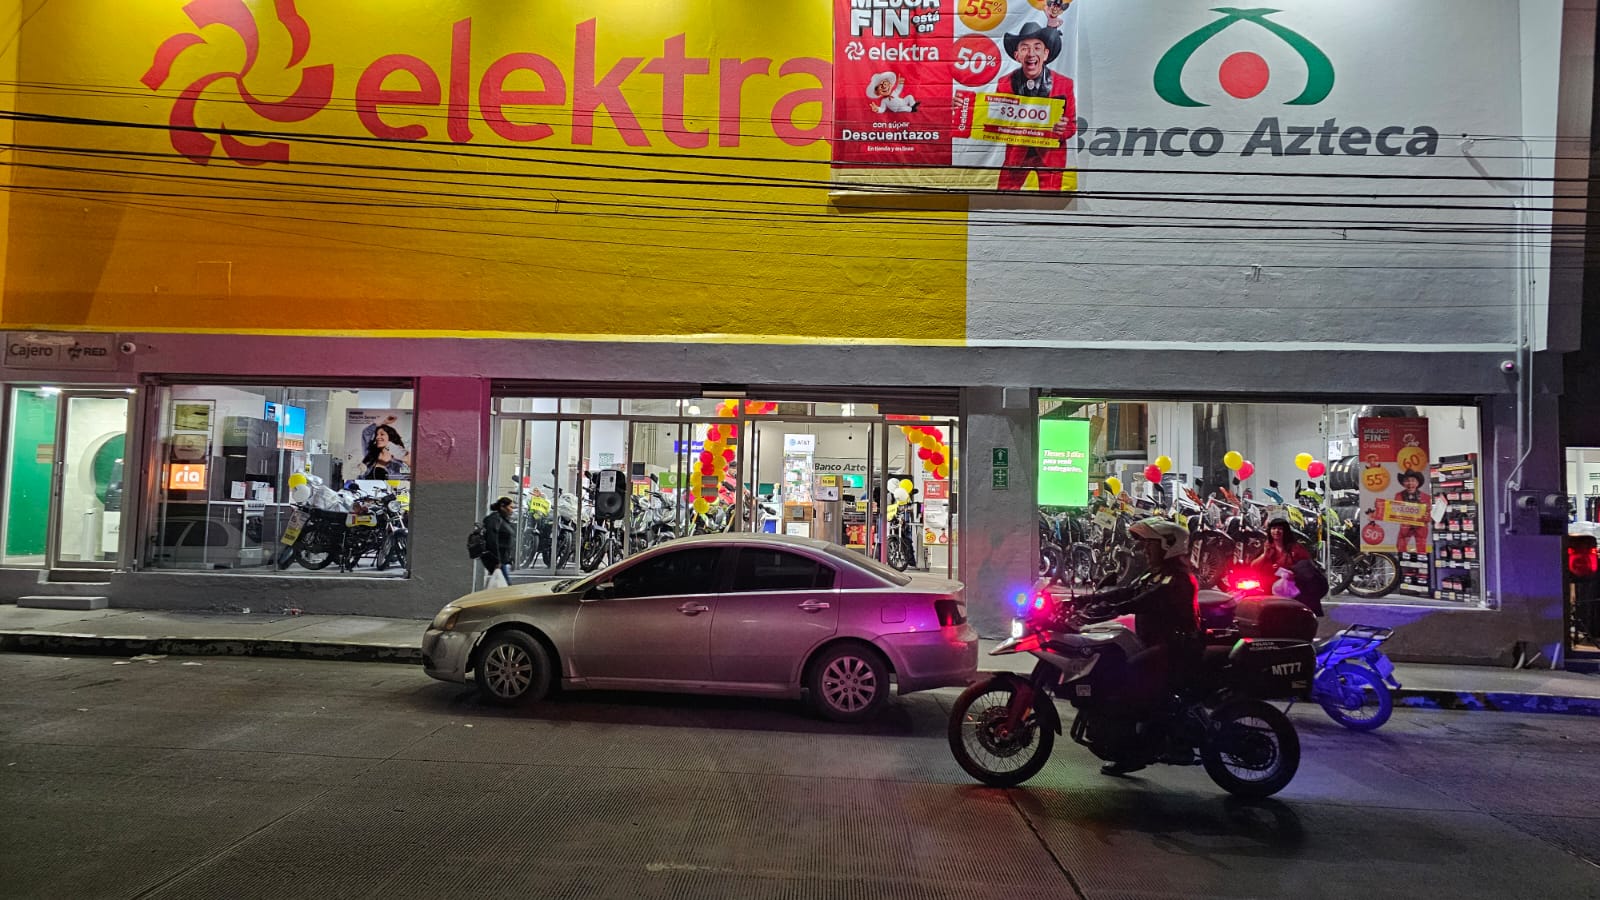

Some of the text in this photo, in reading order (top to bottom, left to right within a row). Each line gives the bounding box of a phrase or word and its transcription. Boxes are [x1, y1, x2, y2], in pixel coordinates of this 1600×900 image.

[850, 8, 910, 36] FIN
[912, 11, 940, 24] está
[918, 23, 934, 32] en
[868, 42, 939, 61] elektra
[953, 46, 997, 74] 50%
[354, 16, 833, 149] elektra
[1000, 107, 1047, 121] $3,000
[888, 121, 910, 130] súper
[842, 129, 940, 141] Descuentazos
[1240, 117, 1439, 157] Azteca
[10, 343, 107, 358] Cajero RED
[1364, 434, 1381, 442] FIN
[175, 465, 200, 483] ria
[815, 463, 867, 472] Banco Azte
[1271, 662, 1302, 675] MT77
